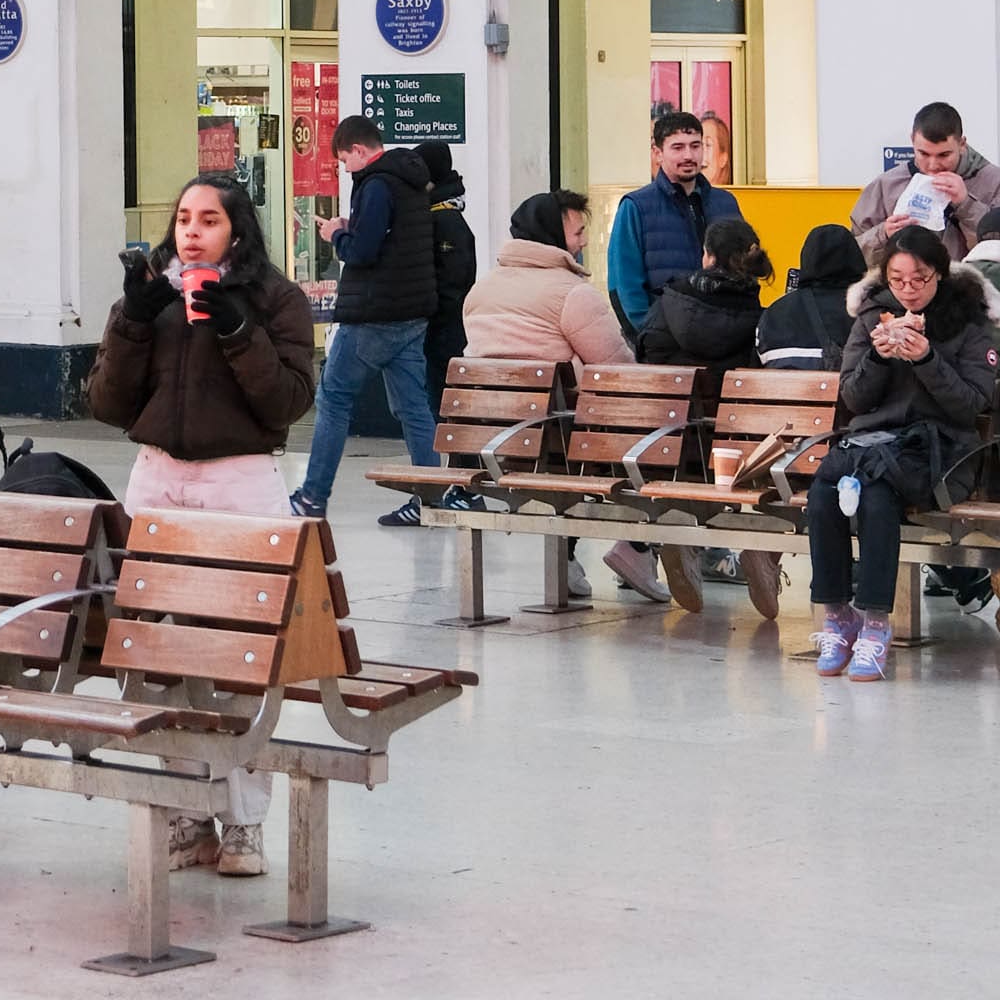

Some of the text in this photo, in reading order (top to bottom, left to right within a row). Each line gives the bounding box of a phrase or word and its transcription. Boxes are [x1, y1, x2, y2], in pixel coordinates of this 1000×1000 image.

[398, 39, 423, 47] Brighton
[394, 80, 420, 89] Toilets
[394, 93, 441, 103] Ticket office
[394, 107, 414, 117] Taxis
[394, 121, 458, 133] Changing Places
[295, 126, 311, 143] 30
